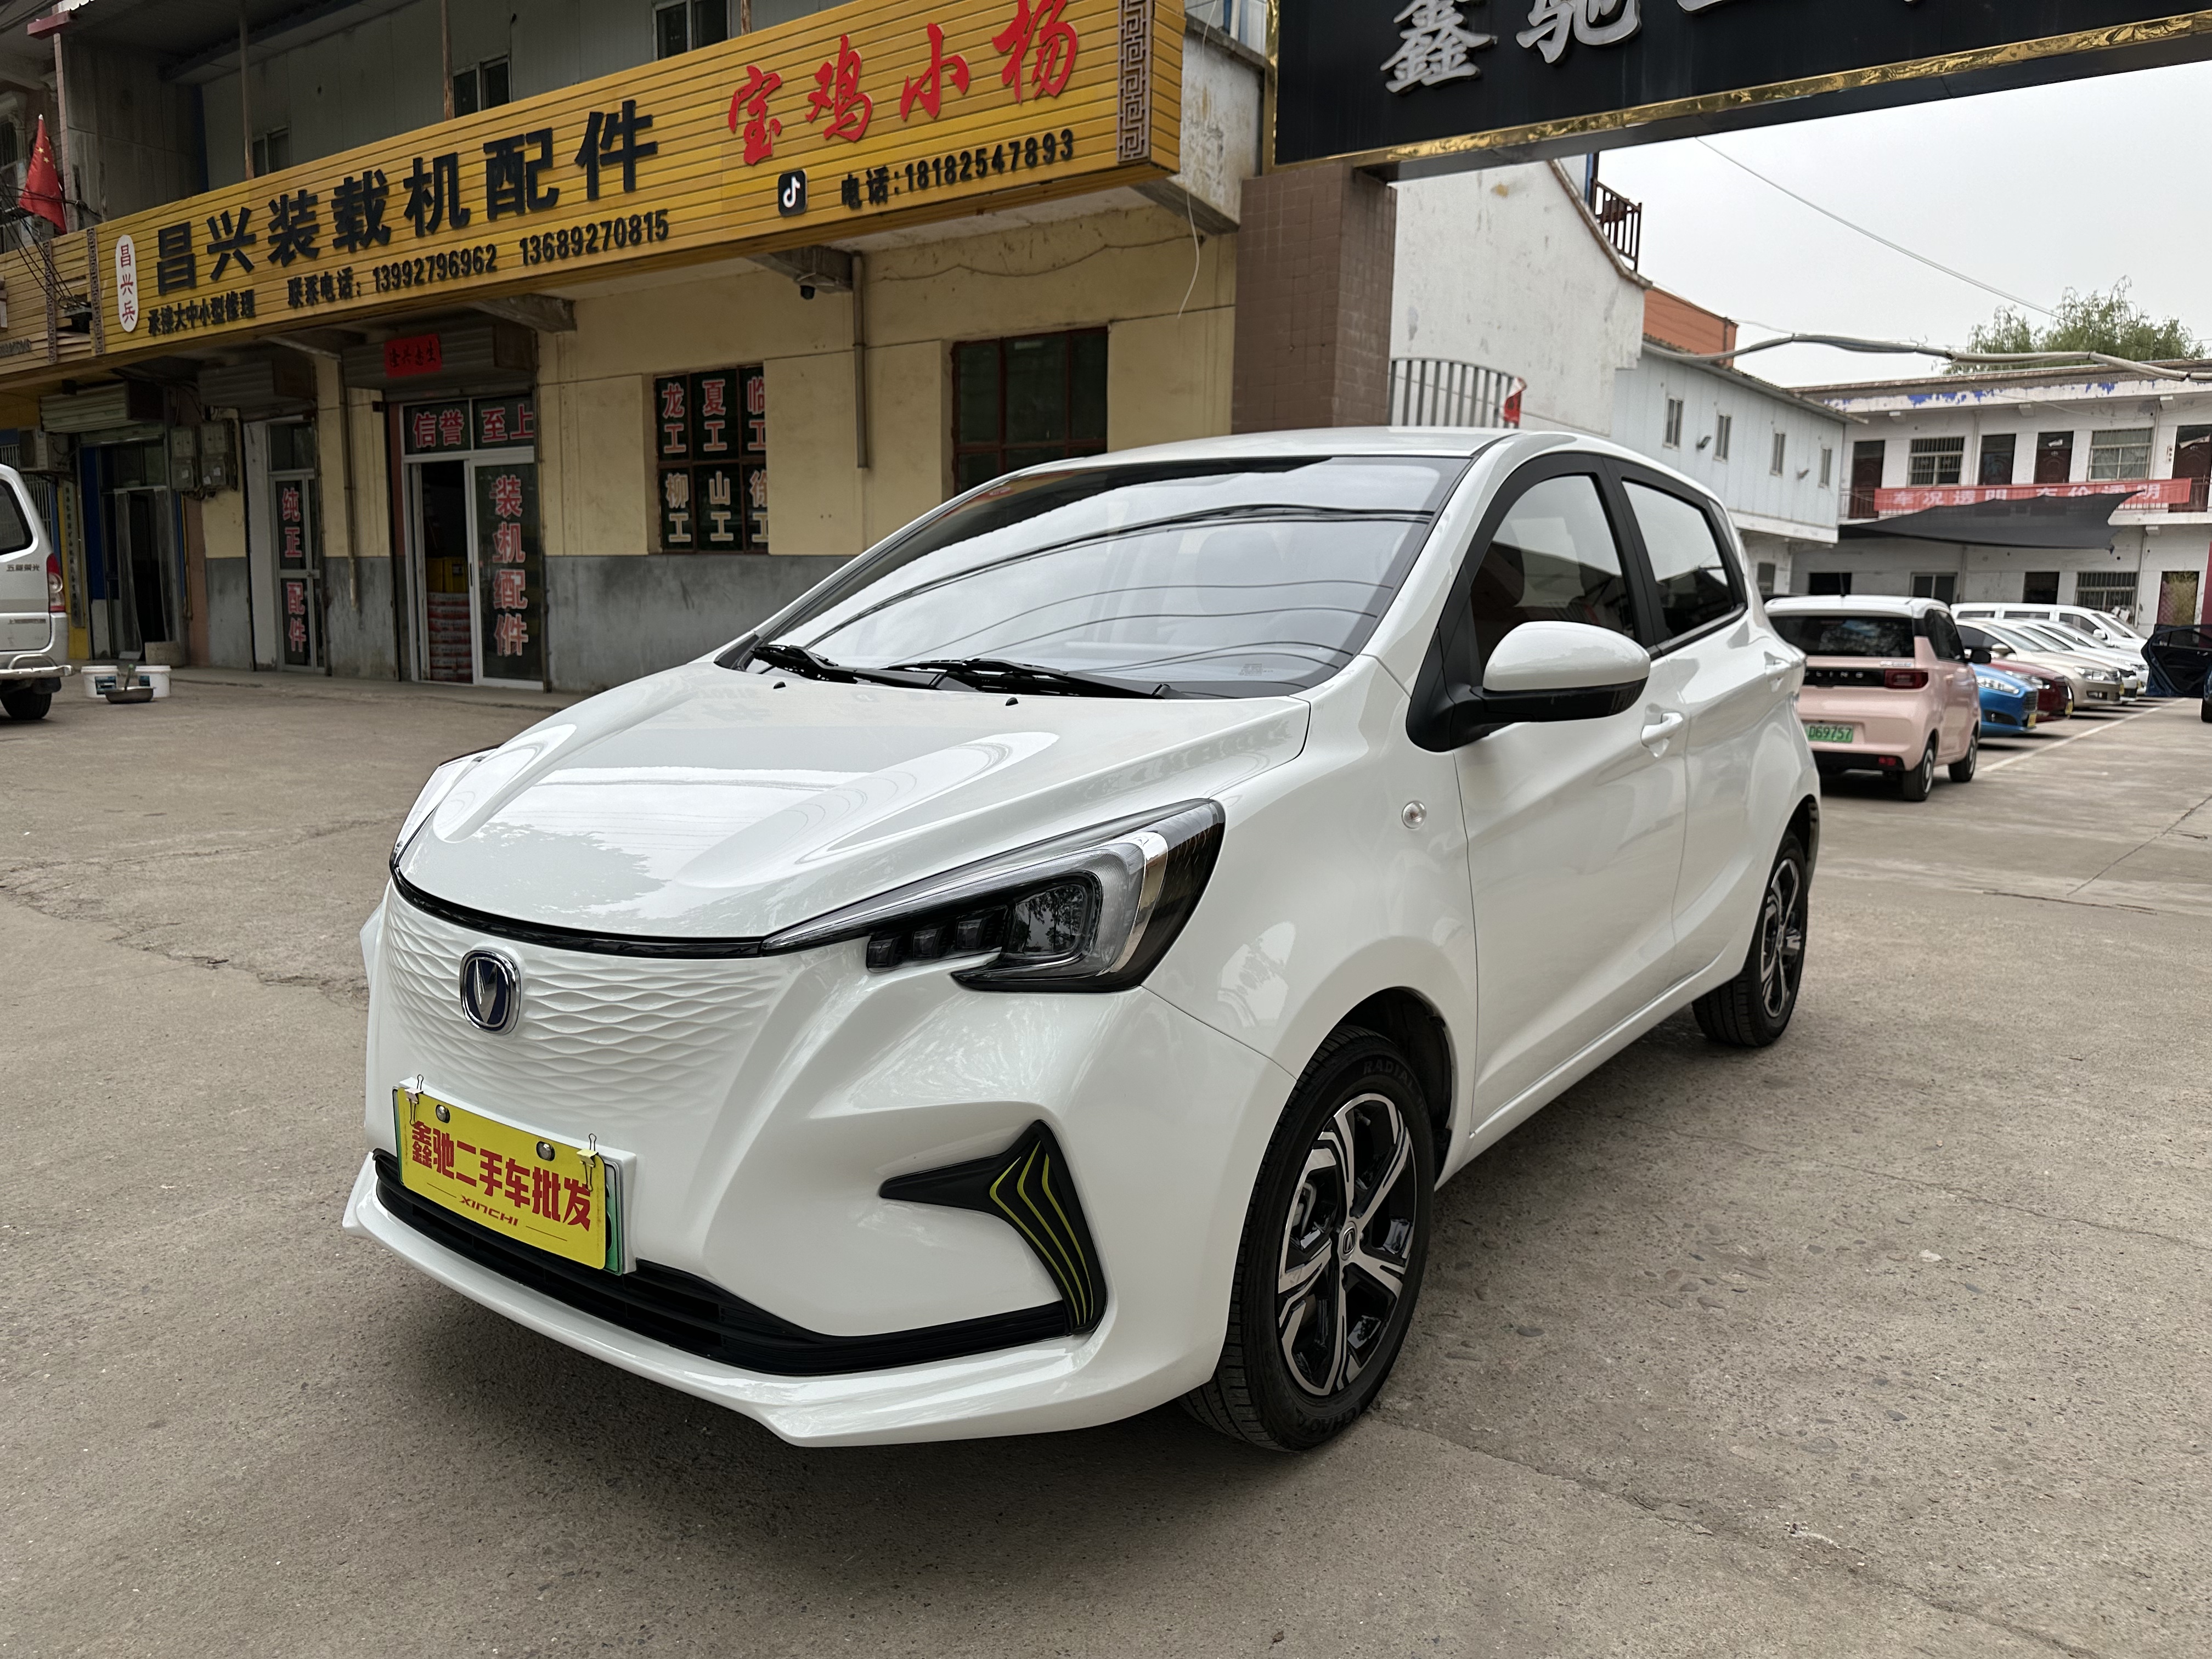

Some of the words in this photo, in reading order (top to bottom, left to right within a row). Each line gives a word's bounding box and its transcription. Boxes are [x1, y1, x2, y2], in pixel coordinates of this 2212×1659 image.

[728, 0, 1077, 164] 宝鸡小杨
[157, 100, 658, 295] 昌兴装载机配件
[520, 209, 668, 266] 13689270815
[121, 244, 136, 324] 昌兴兵
[148, 289, 255, 336] 承接大中小型修理
[413, 404, 534, 448] 信誉至上
[662, 383, 686, 453] 龙工
[702, 379, 727, 452] 夏工
[666, 473, 691, 543] 柳工
[709, 471, 733, 541] 山工
[282, 488, 306, 652] 纯正配件
[412, 1121, 591, 1232] 鑫驰二手车批发
